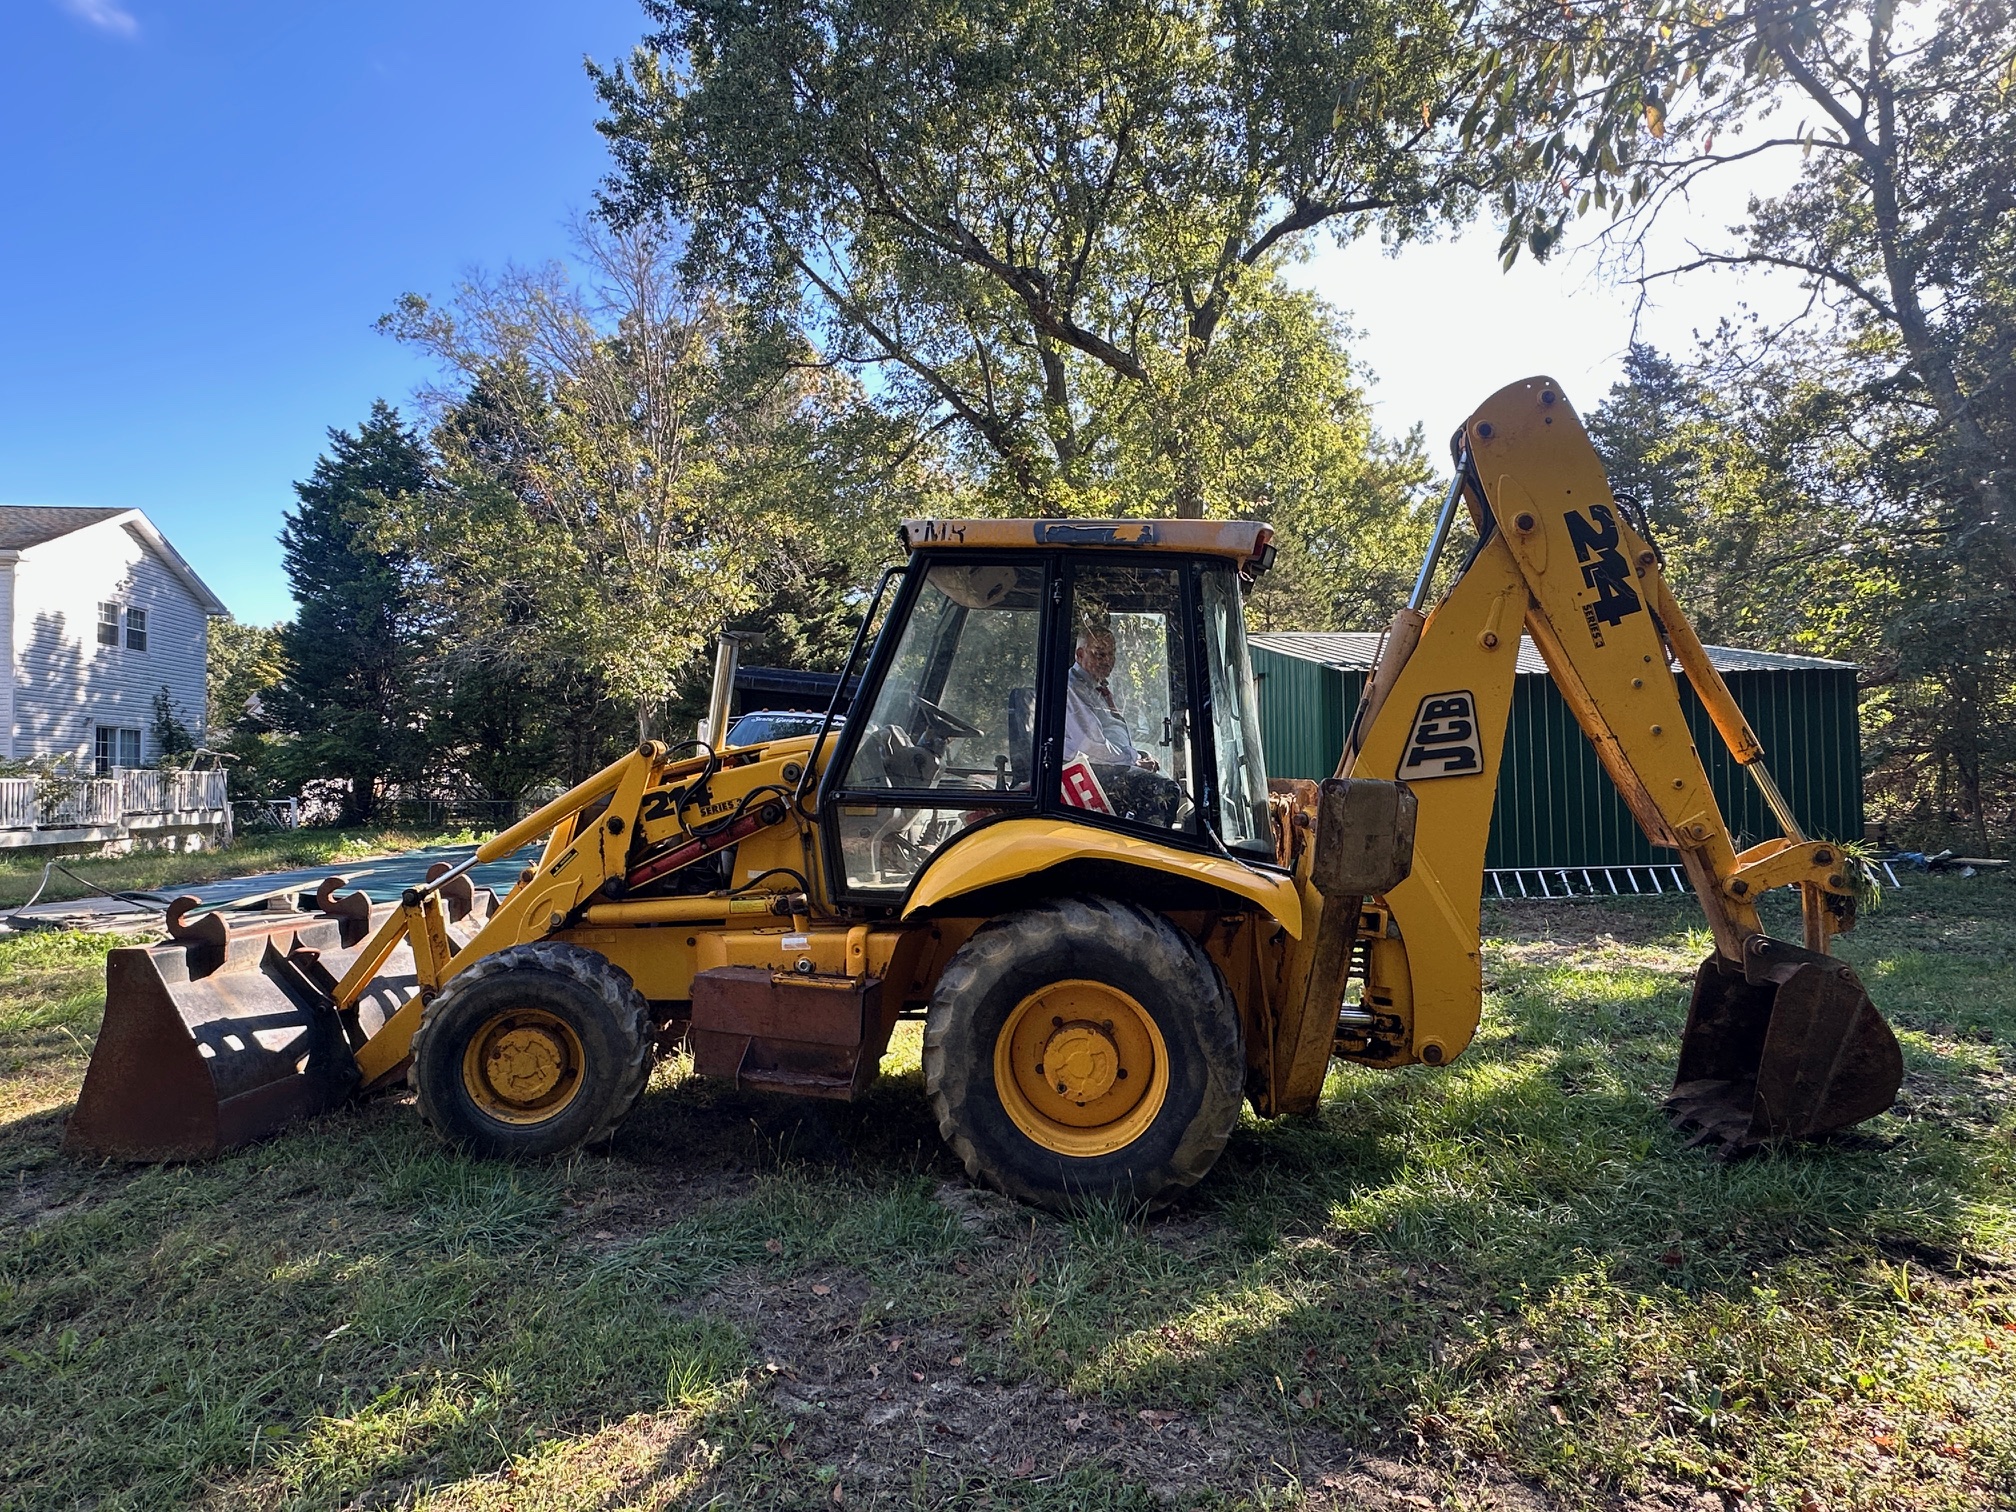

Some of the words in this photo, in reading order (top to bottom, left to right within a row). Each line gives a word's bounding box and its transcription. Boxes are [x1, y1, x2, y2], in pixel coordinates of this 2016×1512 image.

[1563, 504, 1642, 627] 214
[1582, 603, 1601, 639] SERIES
[1406, 697, 1477, 772] JCB
[642, 780, 714, 822] 214
[700, 801, 735, 817] SERIES
